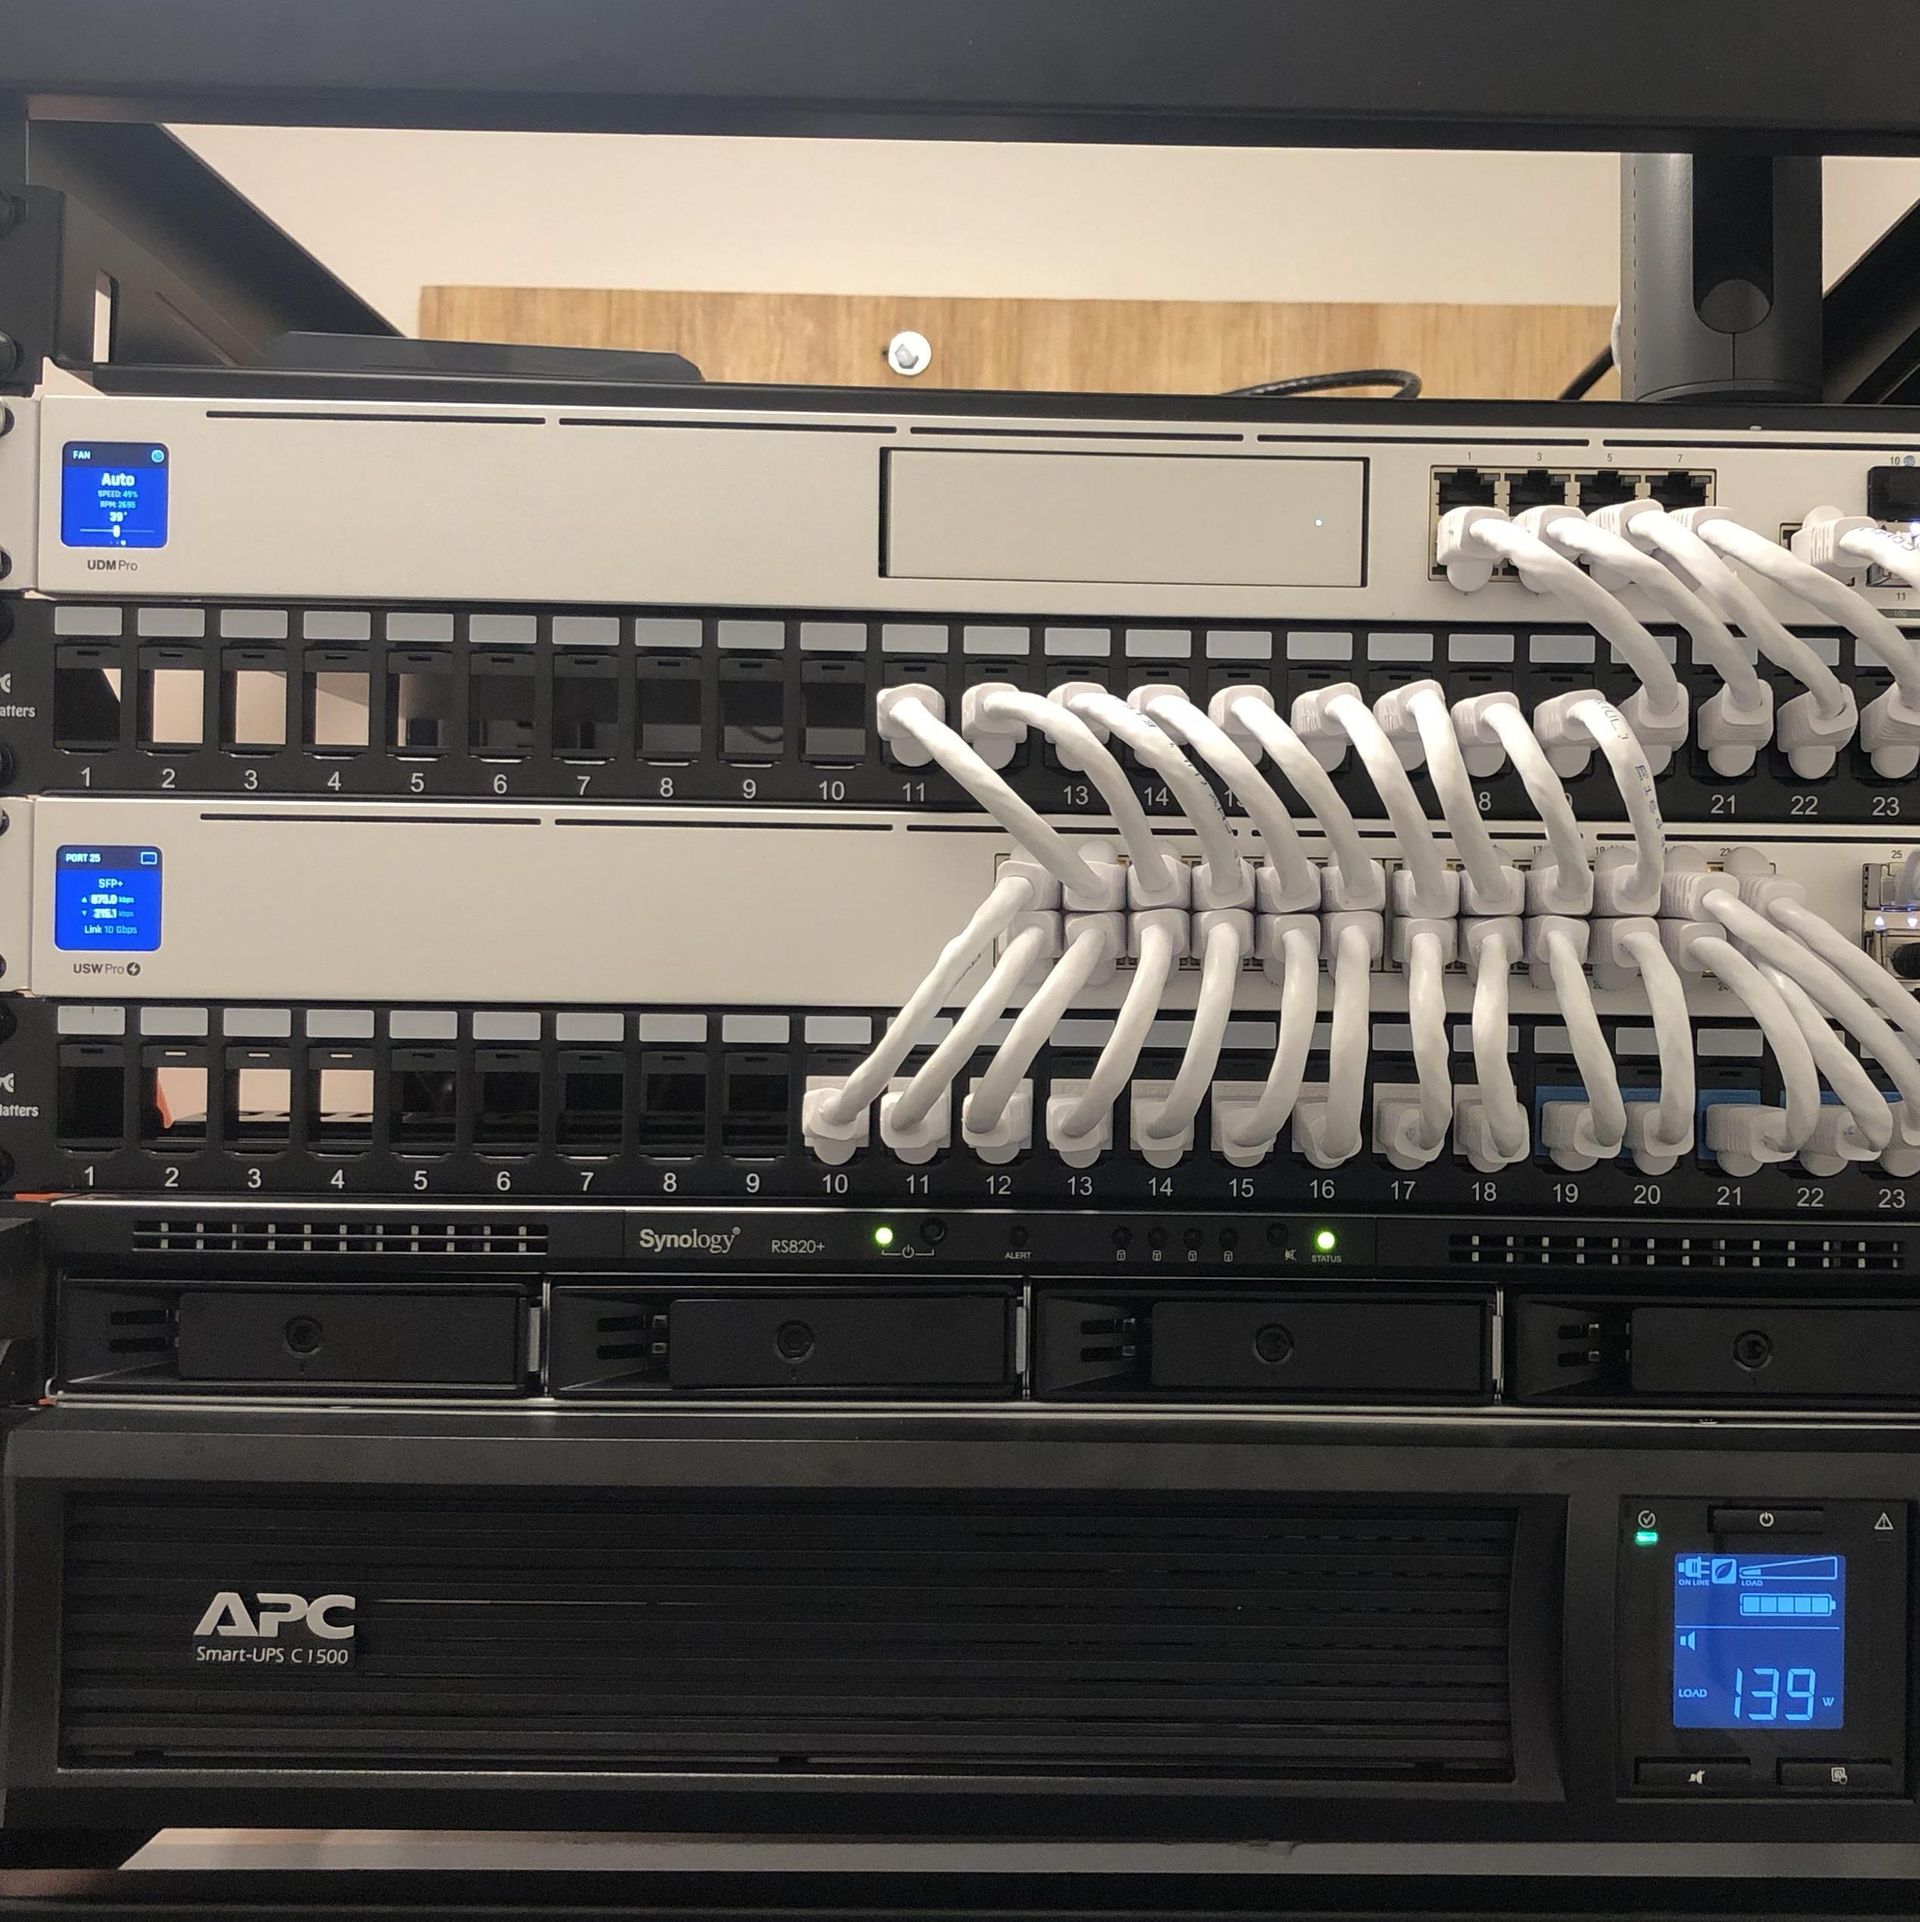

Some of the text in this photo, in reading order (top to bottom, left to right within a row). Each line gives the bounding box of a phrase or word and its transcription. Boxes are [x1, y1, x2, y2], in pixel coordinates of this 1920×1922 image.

[73, 451, 90, 459] FAN
[1536, 451, 1543, 462] 3
[1607, 452, 1613, 463] 5
[1677, 453, 1684, 463] 7
[1890, 457, 1900, 466] 10
[102, 473, 134, 486] Auto
[87, 559, 138, 572] UDM Pro
[1896, 591, 1906, 601] 11
[81, 766, 90, 787] 1
[161, 768, 176, 789] 2
[244, 769, 258, 790] 3
[327, 771, 342, 791] 4
[410, 772, 425, 793] 5
[493, 774, 508, 794] 6
[577, 775, 591, 796] 7
[659, 777, 674, 798] 8
[742, 778, 757, 799] 9
[818, 780, 845, 801] 10
[902, 782, 925, 802] 11
[1063, 785, 1089, 805] 13
[1144, 787, 1169, 806] 14
[1710, 794, 1735, 814] 21
[1790, 795, 1818, 815] 22
[1872, 796, 1900, 817] 23
[66, 854, 100, 862] PORT 25
[1892, 850, 1902, 859] 25
[99, 879, 123, 888] SFP+
[84, 925, 137, 935] Link 10 Gbps
[73, 963, 125, 975] USW Pro
[84, 1166, 1906, 1209] 1 2 3 4 5 6 7 8 9 10 11 12 13 14 15 16 17 18 19 20 21 22 23
[640, 1227, 735, 1253] Synology
[771, 1239, 825, 1254] RS820+
[1004, 1251, 1032, 1260] ALERT
[1311, 1255, 1342, 1263] STATUS
[194, 1592, 355, 1639] APC
[196, 1646, 349, 1665] Smart-UPS C 1500
[1678, 1688, 1708, 1698] LOAD
[1734, 1668, 1816, 1721] 139
